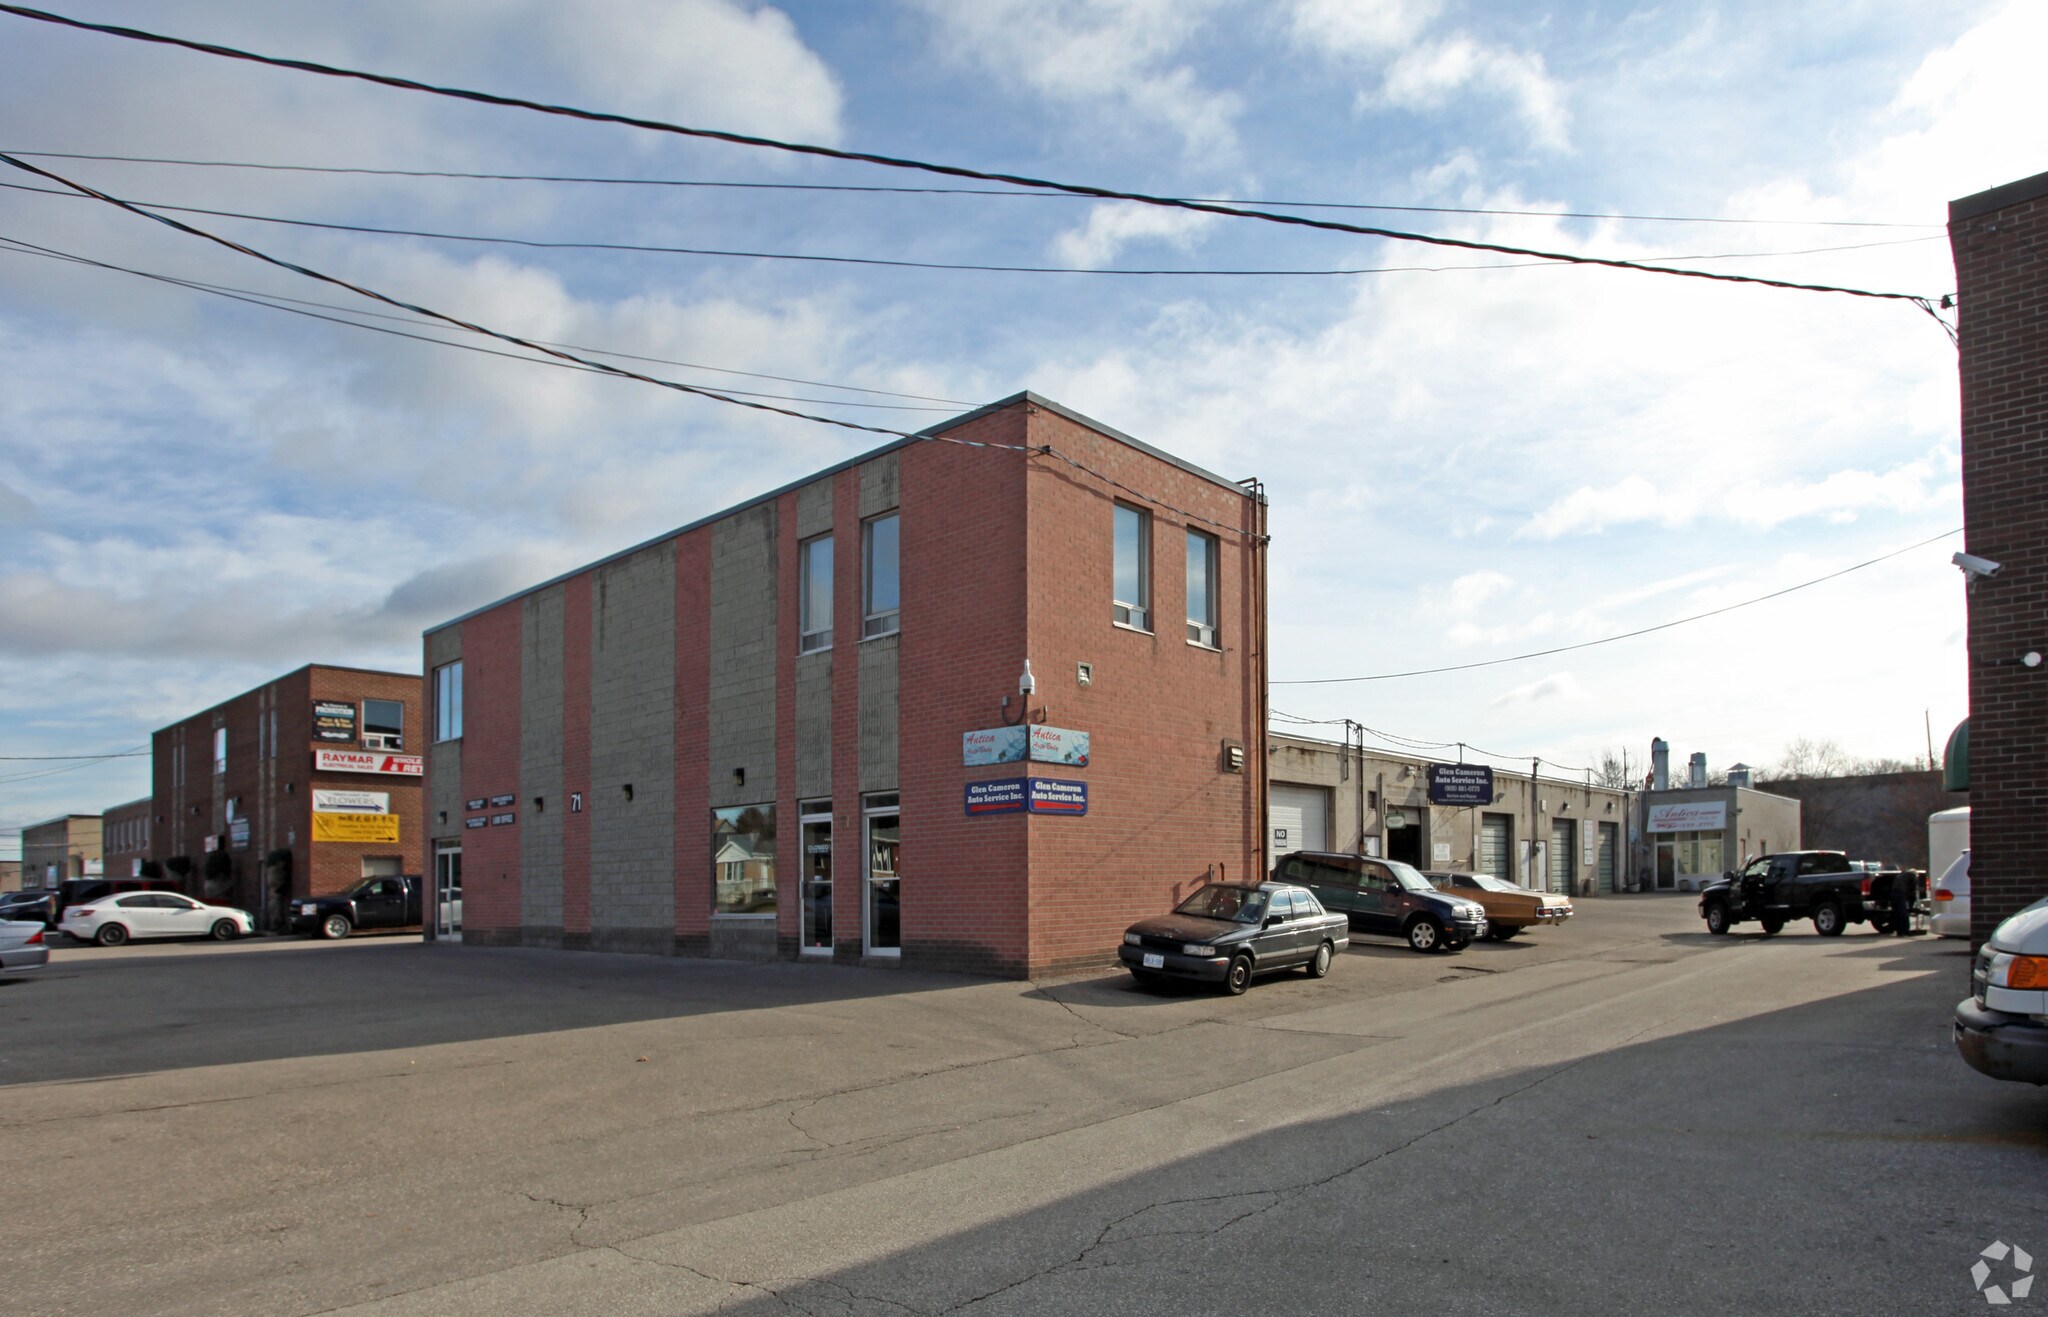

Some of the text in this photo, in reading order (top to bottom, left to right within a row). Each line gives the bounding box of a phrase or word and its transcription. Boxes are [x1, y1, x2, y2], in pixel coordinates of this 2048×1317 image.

[965, 733, 995, 745] Antica
[1032, 728, 1062, 742] Antica
[323, 753, 373, 764] RAYMAR
[1451, 776, 1475, 784] Service
[971, 783, 1020, 794] Glen Cameron
[1035, 781, 1081, 793] Glen Cameron
[571, 793, 581, 811] 71
[967, 791, 1024, 804] Auto Service Inc.
[1032, 791, 1085, 803] Auto Service Inc.
[1276, 830, 1285, 838] NO
